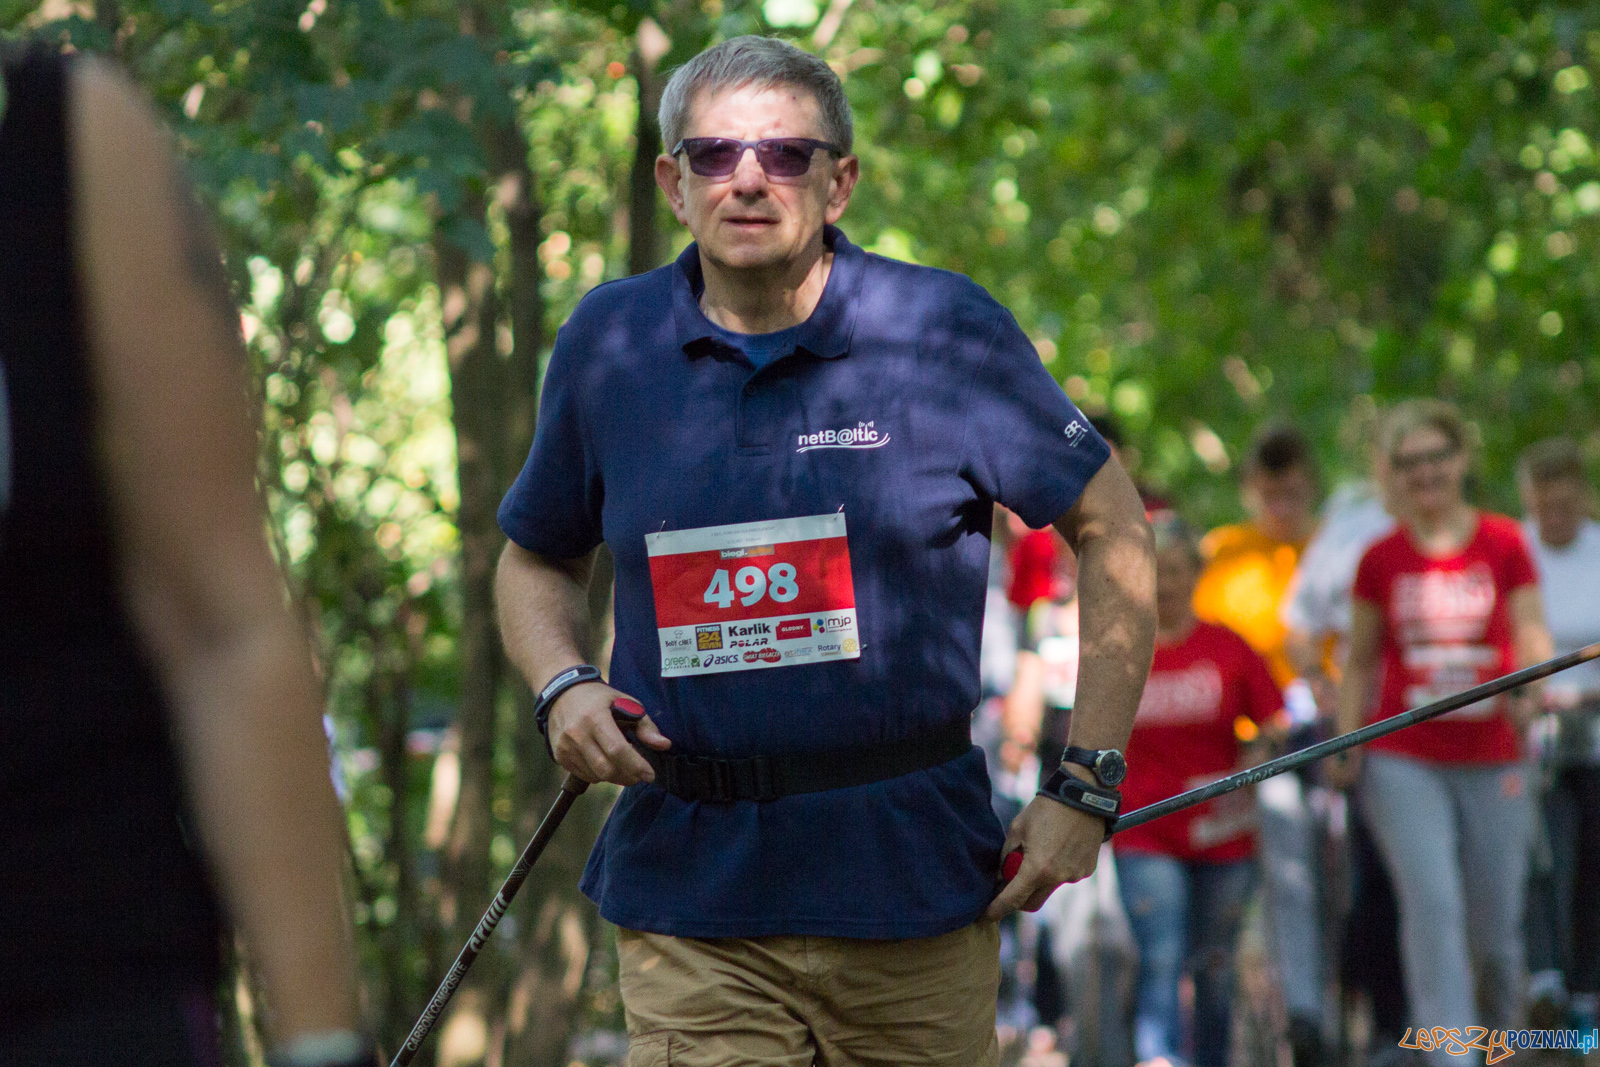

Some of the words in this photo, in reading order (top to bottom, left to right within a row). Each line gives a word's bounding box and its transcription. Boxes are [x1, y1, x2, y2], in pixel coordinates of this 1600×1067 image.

[703, 562, 799, 609] 498
[827, 616, 852, 627] mjp
[728, 623, 771, 637] Karlik
[698, 631, 721, 643] 24
[730, 638, 768, 648] POLAR
[817, 644, 841, 653] Rotary
[664, 656, 690, 670] green
[407, 1010, 432, 1051] CARBON
[431, 961, 468, 1014] COMPOSITE
